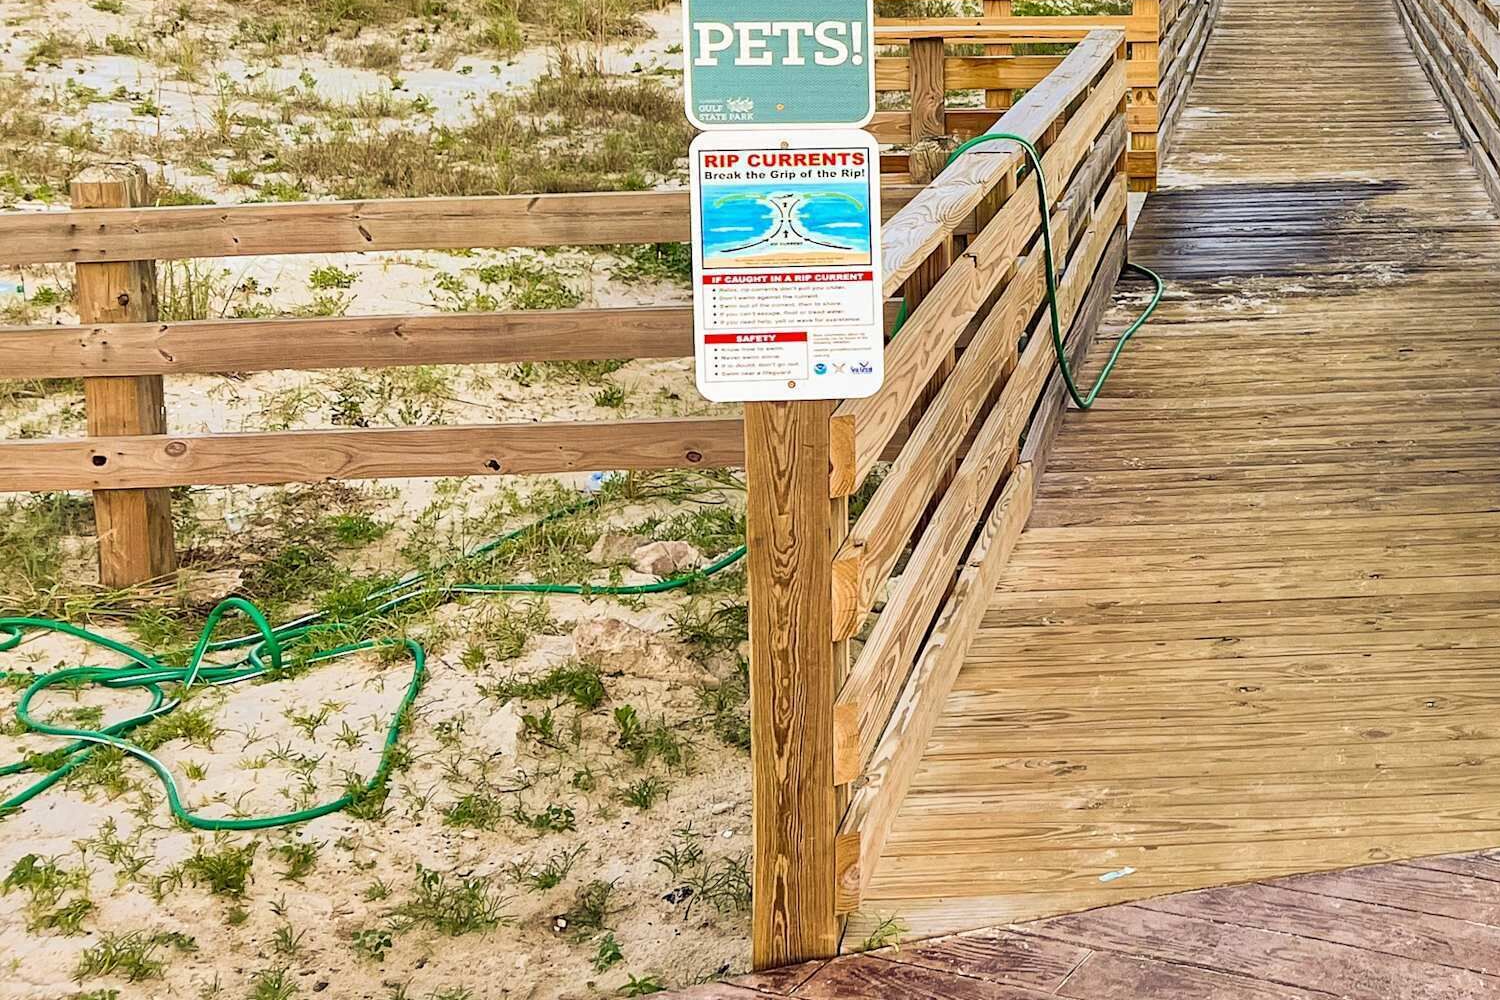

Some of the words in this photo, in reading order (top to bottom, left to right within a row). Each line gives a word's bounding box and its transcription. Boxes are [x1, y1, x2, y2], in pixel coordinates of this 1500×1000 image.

[693, 21, 863, 66] PETS!
[704, 154, 740, 168] RIP
[747, 152, 865, 168] CURRENTS
[704, 171, 741, 180] Break
[746, 170, 766, 179] the
[770, 170, 796, 180] Grip
[800, 169, 812, 178] of
[817, 169, 837, 178] the
[841, 168, 865, 179] Rip!
[736, 334, 779, 344] SAFETY
